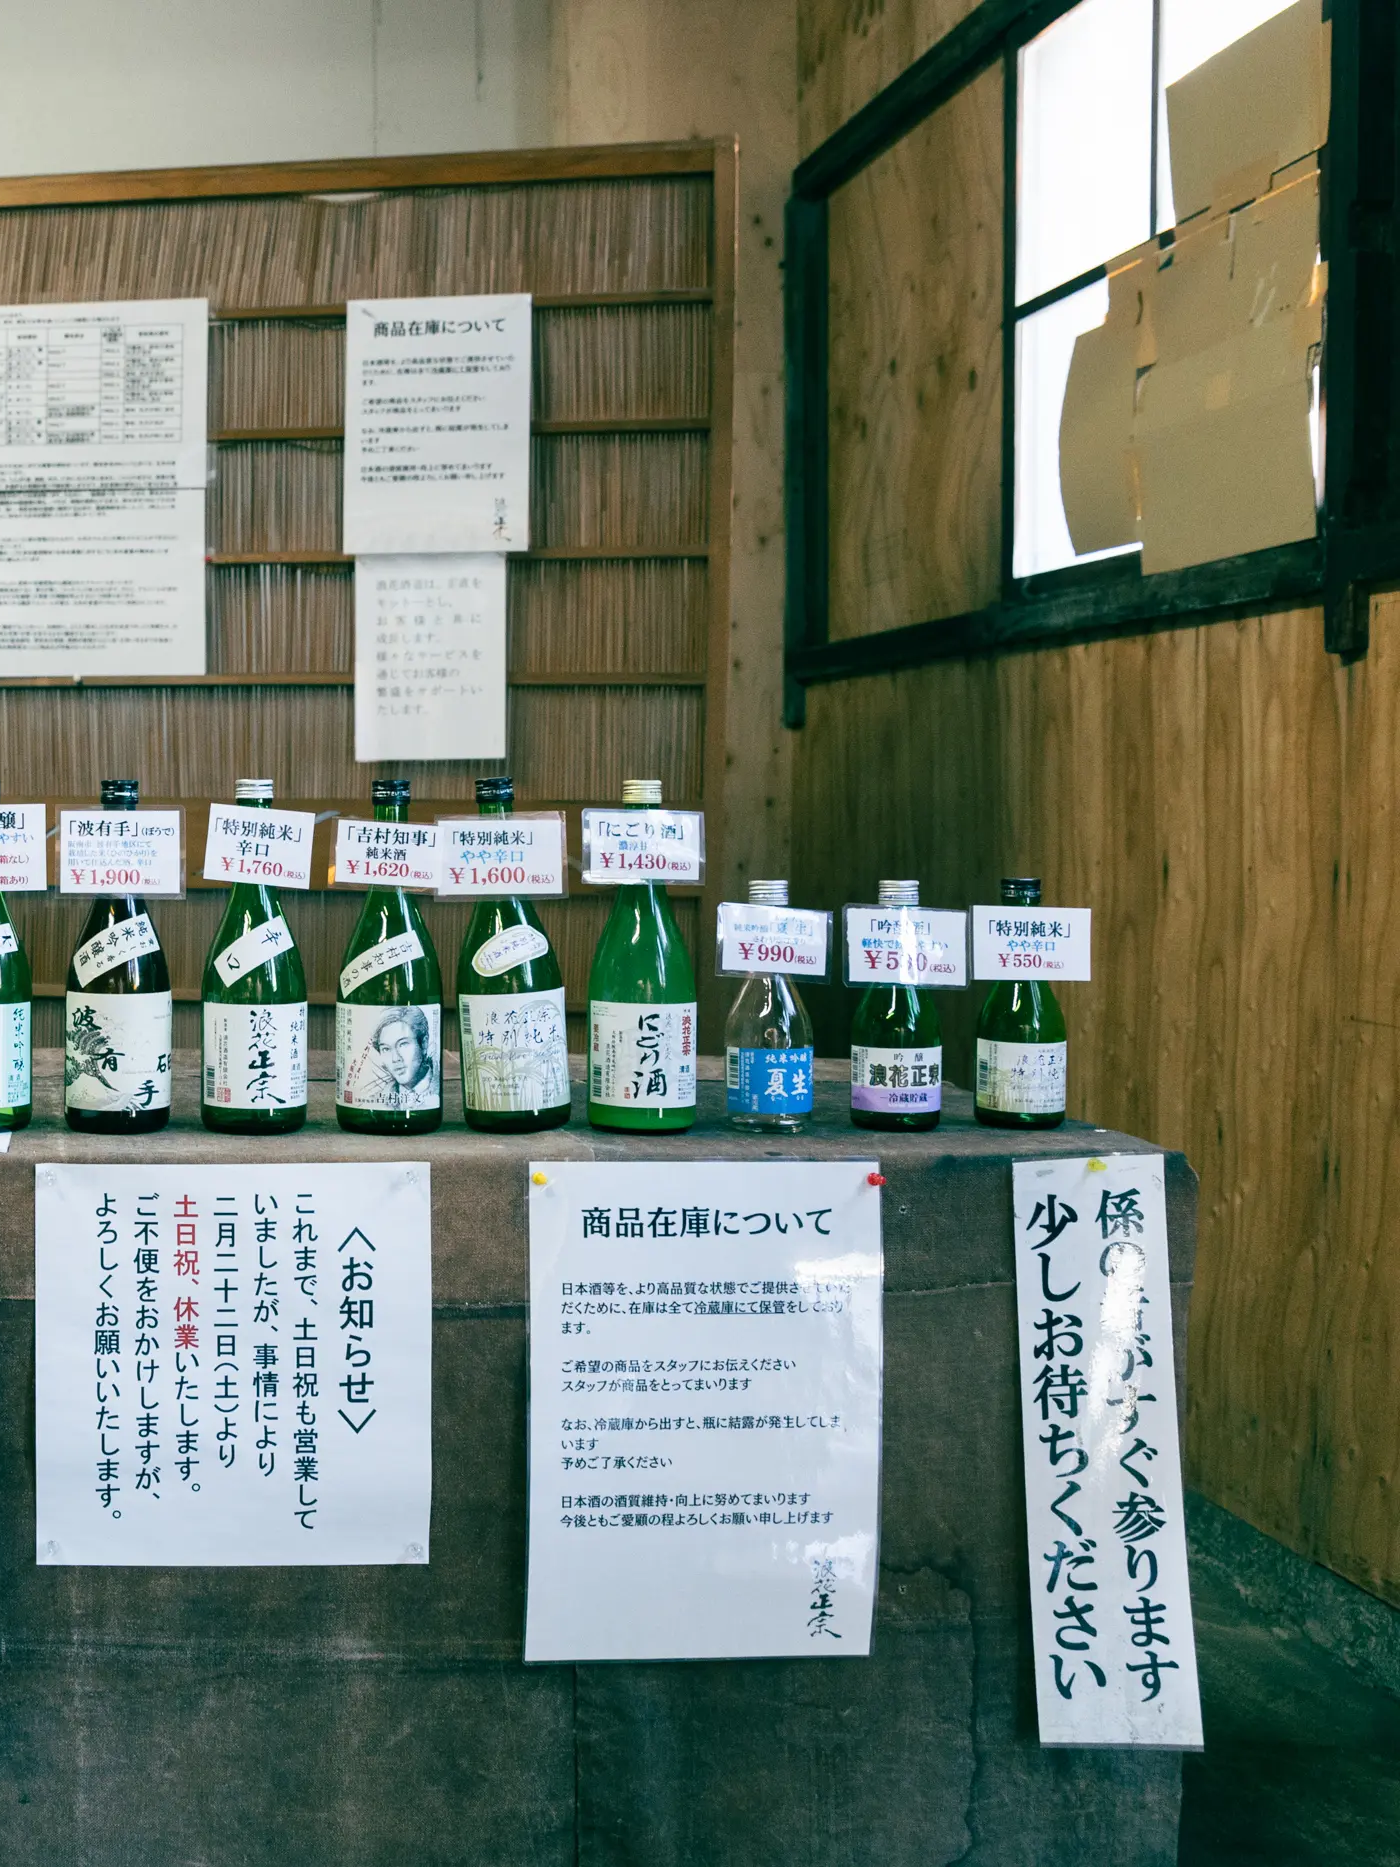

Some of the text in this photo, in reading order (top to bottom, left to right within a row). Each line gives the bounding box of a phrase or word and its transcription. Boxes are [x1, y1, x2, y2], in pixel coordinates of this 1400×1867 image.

[373, 317, 506, 338] 商品在庫について
[215, 817, 302, 842] 「特別純米」
[348, 826, 436, 847] 「吉村知事」
[452, 831, 533, 845] 「特別純米」
[598, 821, 684, 840] 「にごり酒」
[236, 840, 270, 857] 辛口
[366, 847, 407, 861] 純米酒
[461, 849, 523, 864] やや辛口
[989, 920, 1070, 938] 「特別純米」
[1007, 940, 1055, 952] やや辛口
[246, 1009, 286, 1103] 浪花正宗
[631, 1014, 667, 1099] にごり酒
[764, 1068, 808, 1097] 夏生
[581, 1206, 834, 1239] 商品在庫について
[214, 1197, 239, 1468] 二月二十二日(土)より
[253, 1193, 279, 1477] いましたが、事情により
[561, 1321, 592, 1335] ます。
[133, 1193, 160, 1500] ご不便をおかけしますが、
[173, 1193, 201, 1492] 土日祝、休業いたします。
[94, 1193, 121, 1519] よろしくお願いいたします。
[292, 1193, 319, 1530] これまで、土日祝も営業して
[561, 1359, 797, 1374] ご希望の商品をスタッフにお伝えください
[561, 1378, 752, 1393] スタッフが商品をとってまいります
[561, 1414, 841, 1431] なお、冷蔵庫から出すと、瓶に結露が発生してしま
[561, 1438, 599, 1452] います
[1026, 1194, 1108, 1701] 少しお待ちください
[1095, 1187, 1179, 1704] 係のがすぐ参ります
[561, 1456, 673, 1470] 予めご了承ください
[561, 1493, 812, 1510] 日本酒の酒質維持・向上に努めてまいります
[560, 1511, 834, 1528] 今後ともご愛顧の程よろしくお願い申し上げます
